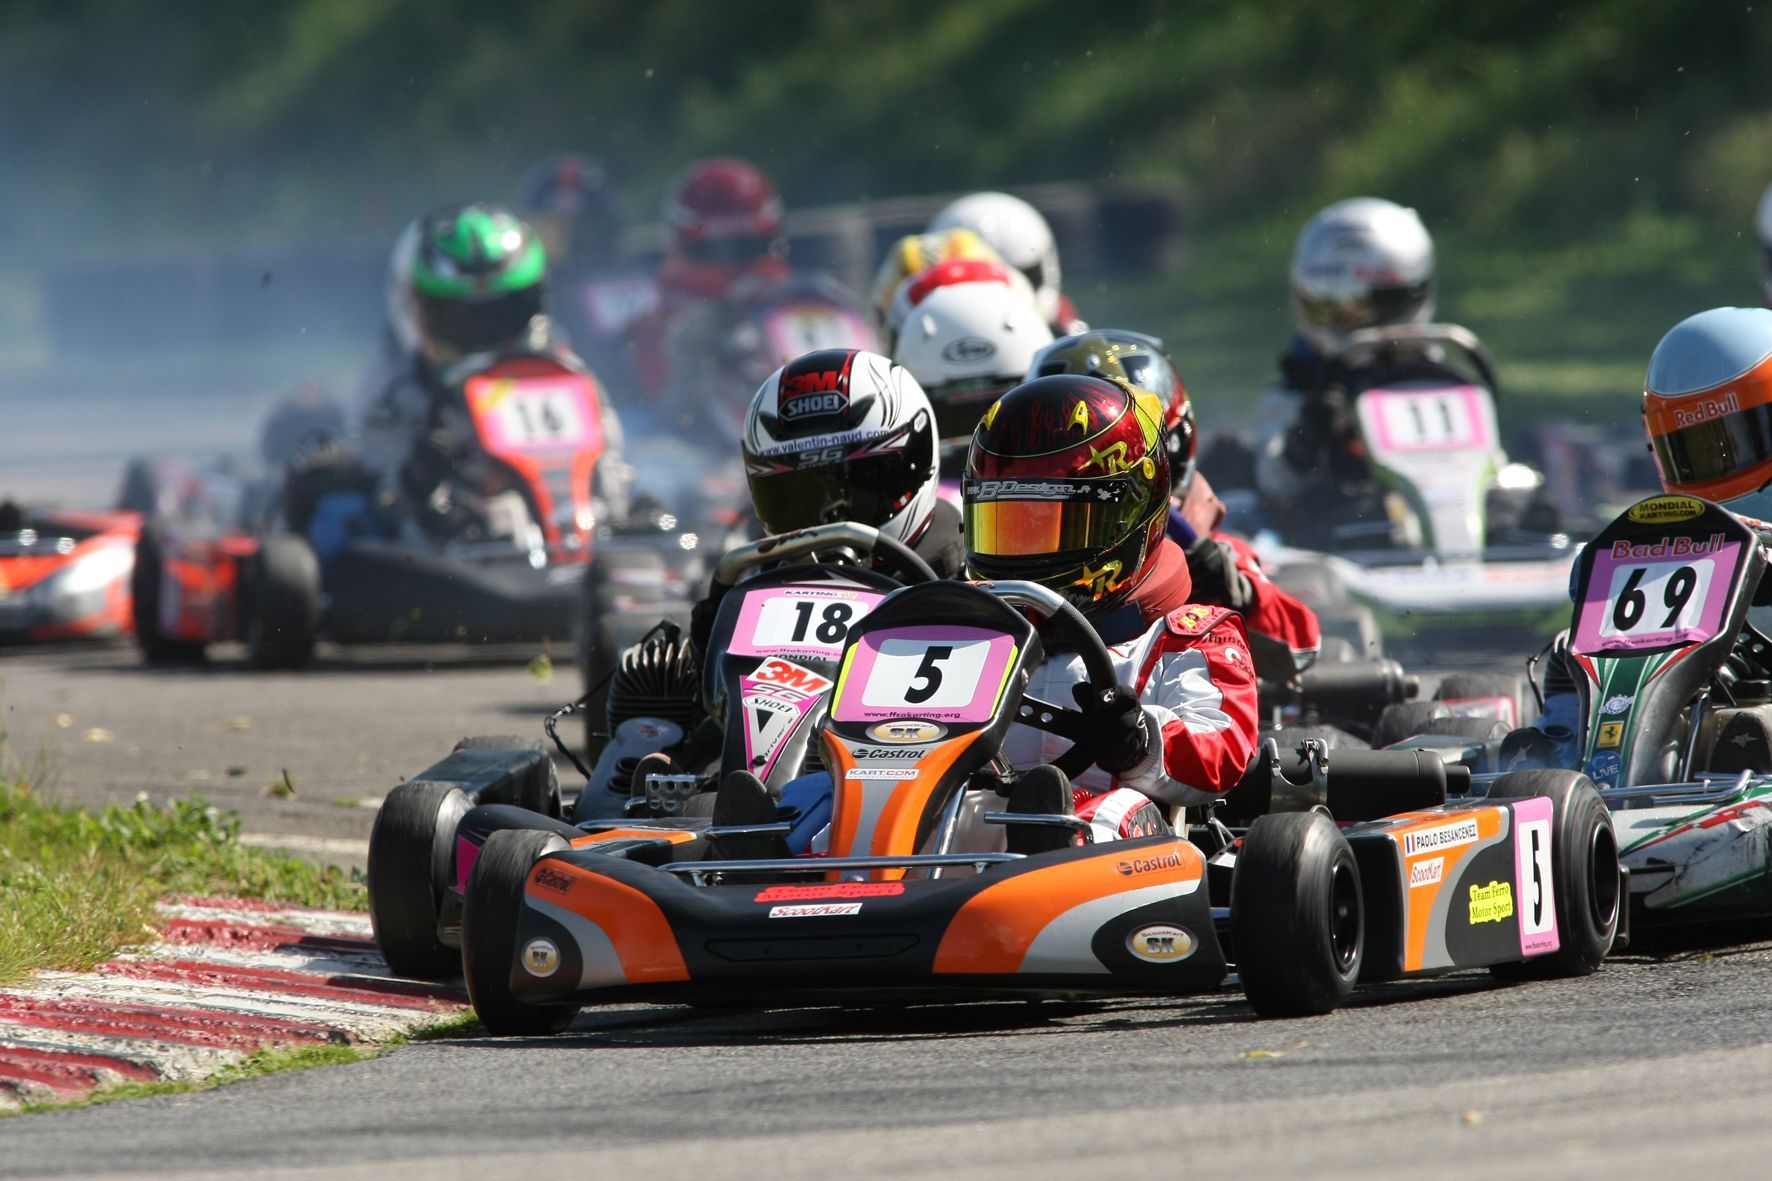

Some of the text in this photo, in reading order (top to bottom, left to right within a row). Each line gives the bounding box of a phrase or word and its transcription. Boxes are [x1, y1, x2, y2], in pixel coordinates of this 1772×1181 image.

[786, 371, 839, 399] 3M
[517, 400, 562, 434] 16
[787, 394, 839, 417] SHOEI
[1409, 397, 1454, 436] 11
[1675, 393, 1740, 428] Red Bull
[1640, 501, 1695, 511] MONDIAL
[1611, 533, 1726, 560] Bad Bull
[1612, 566, 1698, 632] 69
[791, 601, 853, 644] 18
[756, 661, 829, 693] 3M
[903, 645, 954, 704] 5
[754, 698, 793, 713] SHOEI
[868, 749, 926, 759] Castrol
[1416, 824, 1477, 849] PAOLO BESANCENEZ
[1133, 854, 1182, 874] Castrol
[1531, 829, 1543, 927] 5
[1472, 885, 1510, 902] Team Ferro
[771, 905, 859, 916] ScootKart
[1472, 902, 1511, 919] Motor Sport
[1146, 937, 1176, 954] SK
